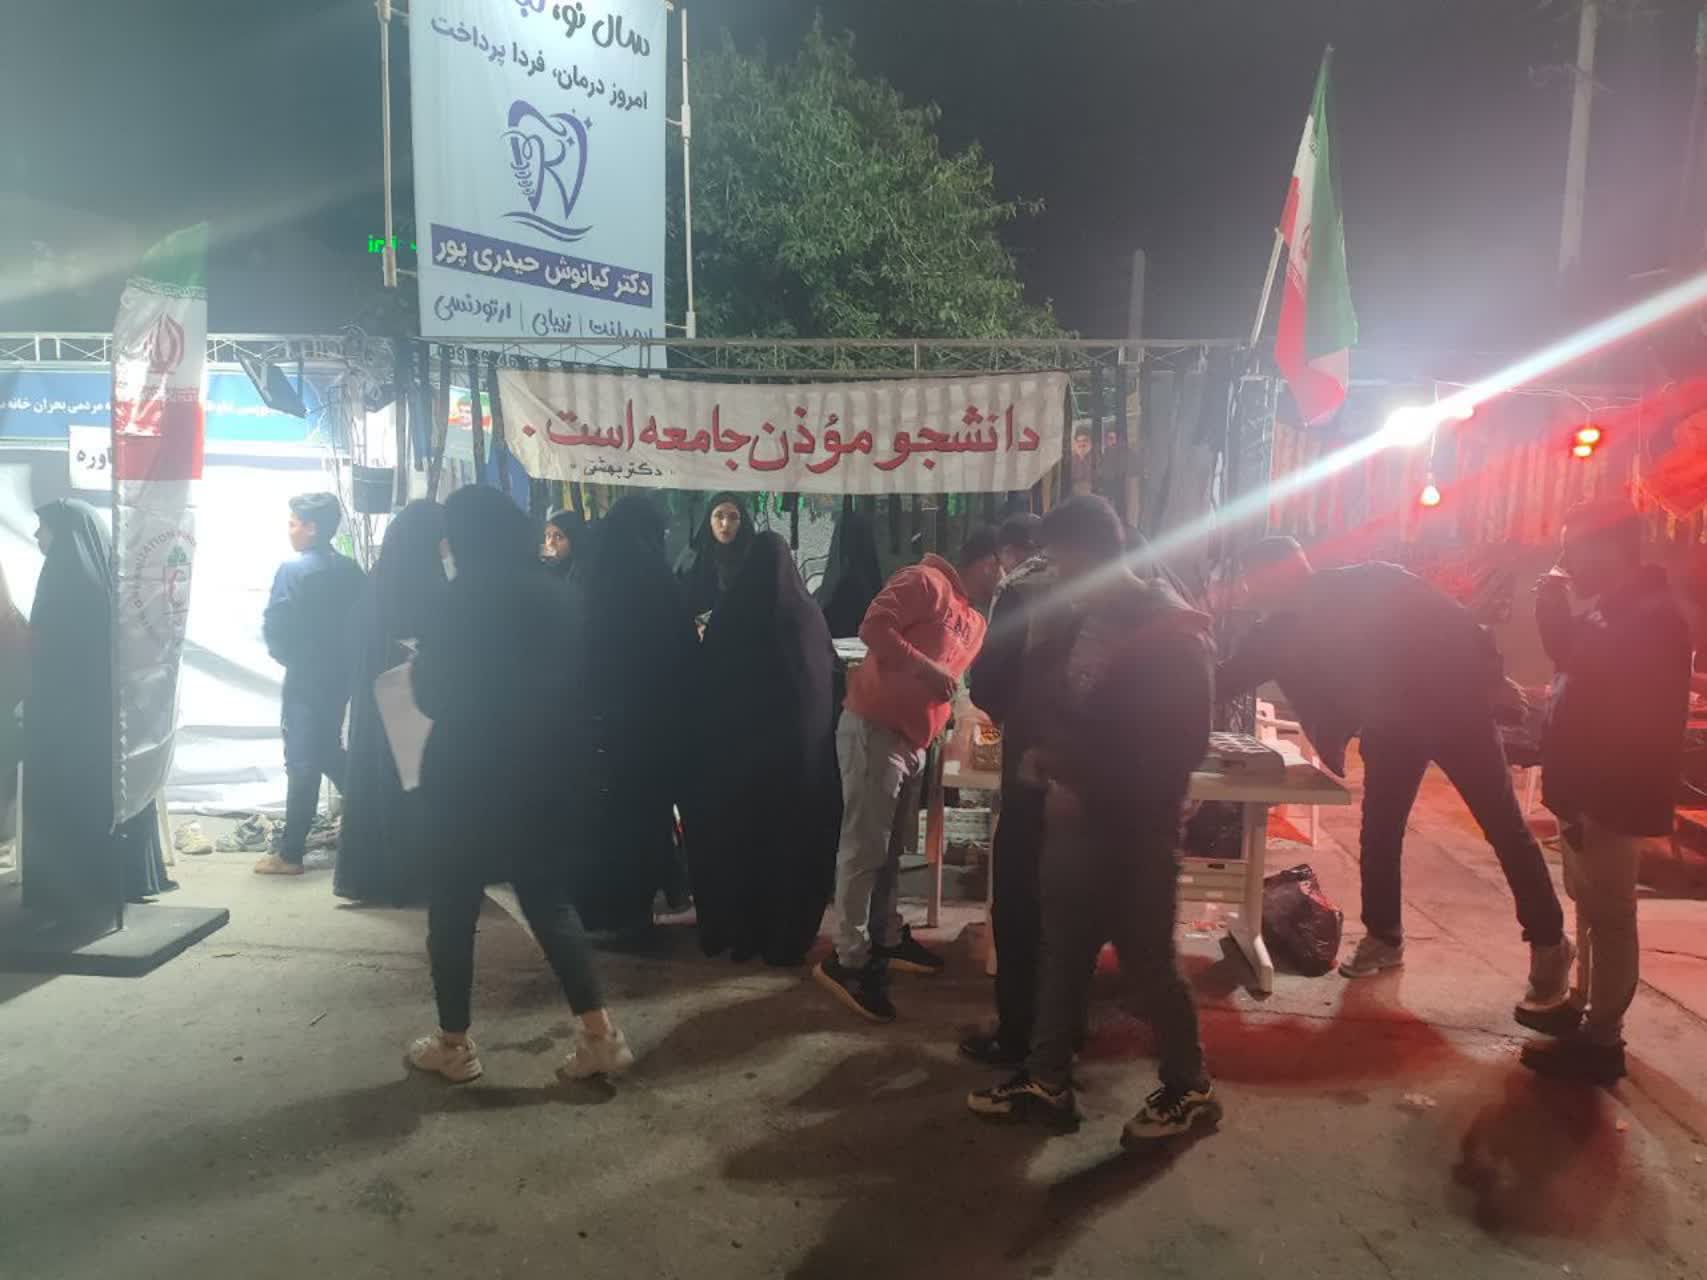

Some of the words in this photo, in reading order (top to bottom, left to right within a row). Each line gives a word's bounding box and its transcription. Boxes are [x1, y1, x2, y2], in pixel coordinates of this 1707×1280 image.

[431, 17, 506, 67] پرداخت
[592, 13, 651, 57] سال
[512, 42, 546, 77] فردا
[608, 83, 648, 111] امروز
[434, 239, 468, 268] پور
[473, 249, 540, 274] حیدری
[544, 255, 611, 291] کیانوش
[614, 272, 651, 298] دکتر
[640, 404, 751, 470] جامعه
[747, 406, 871, 473] مؤذن
[872, 404, 1041, 472] دانشجو
[76, 447, 112, 470] اوره
[622, 462, 663, 479] دکتر
